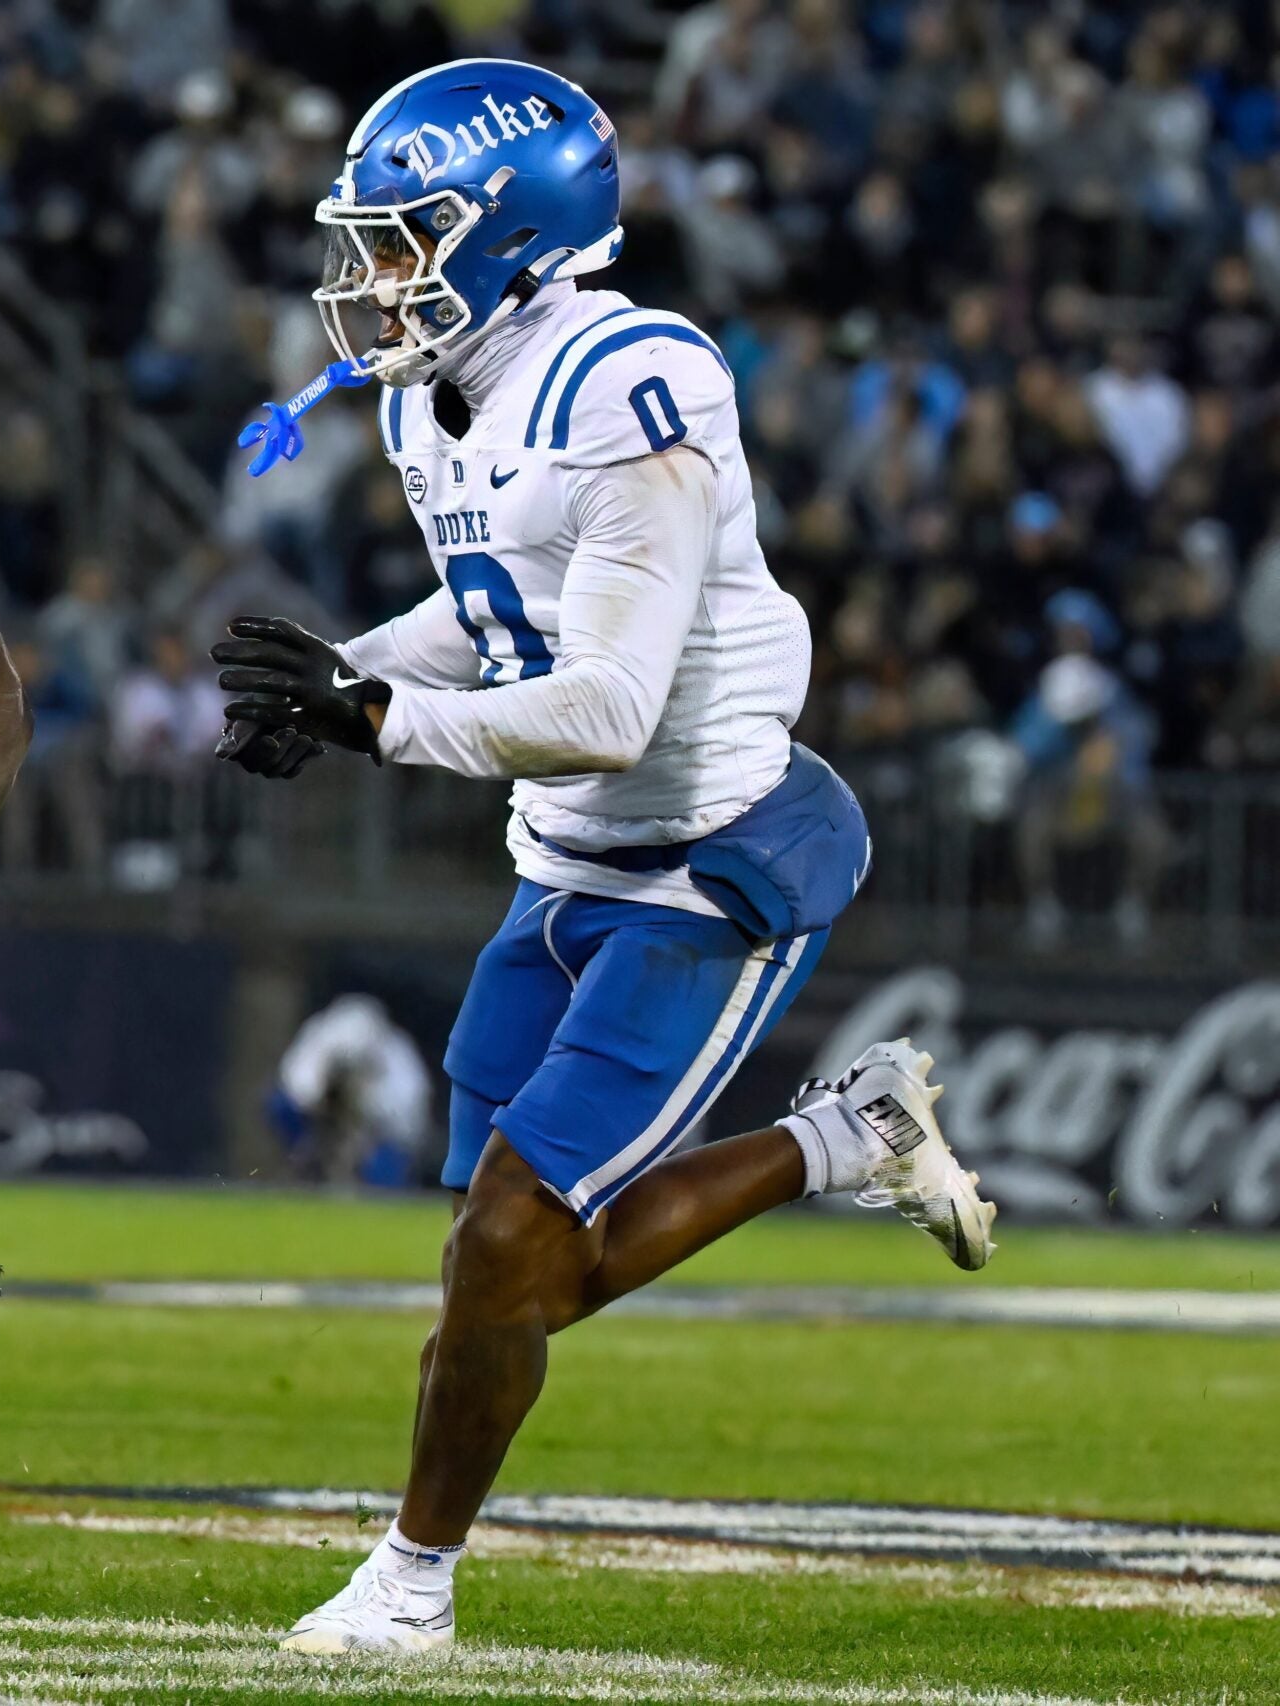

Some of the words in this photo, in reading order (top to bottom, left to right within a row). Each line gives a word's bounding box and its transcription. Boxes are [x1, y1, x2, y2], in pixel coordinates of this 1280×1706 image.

[395, 94, 553, 189] Duke
[287, 375, 328, 417] NXTRND
[628, 376, 688, 452] 0
[407, 473, 424, 488] ACC
[451, 460, 464, 483] D
[432, 510, 491, 546] DUKE
[445, 552, 555, 687] 0
[854, 1093, 928, 1157] NIKE
